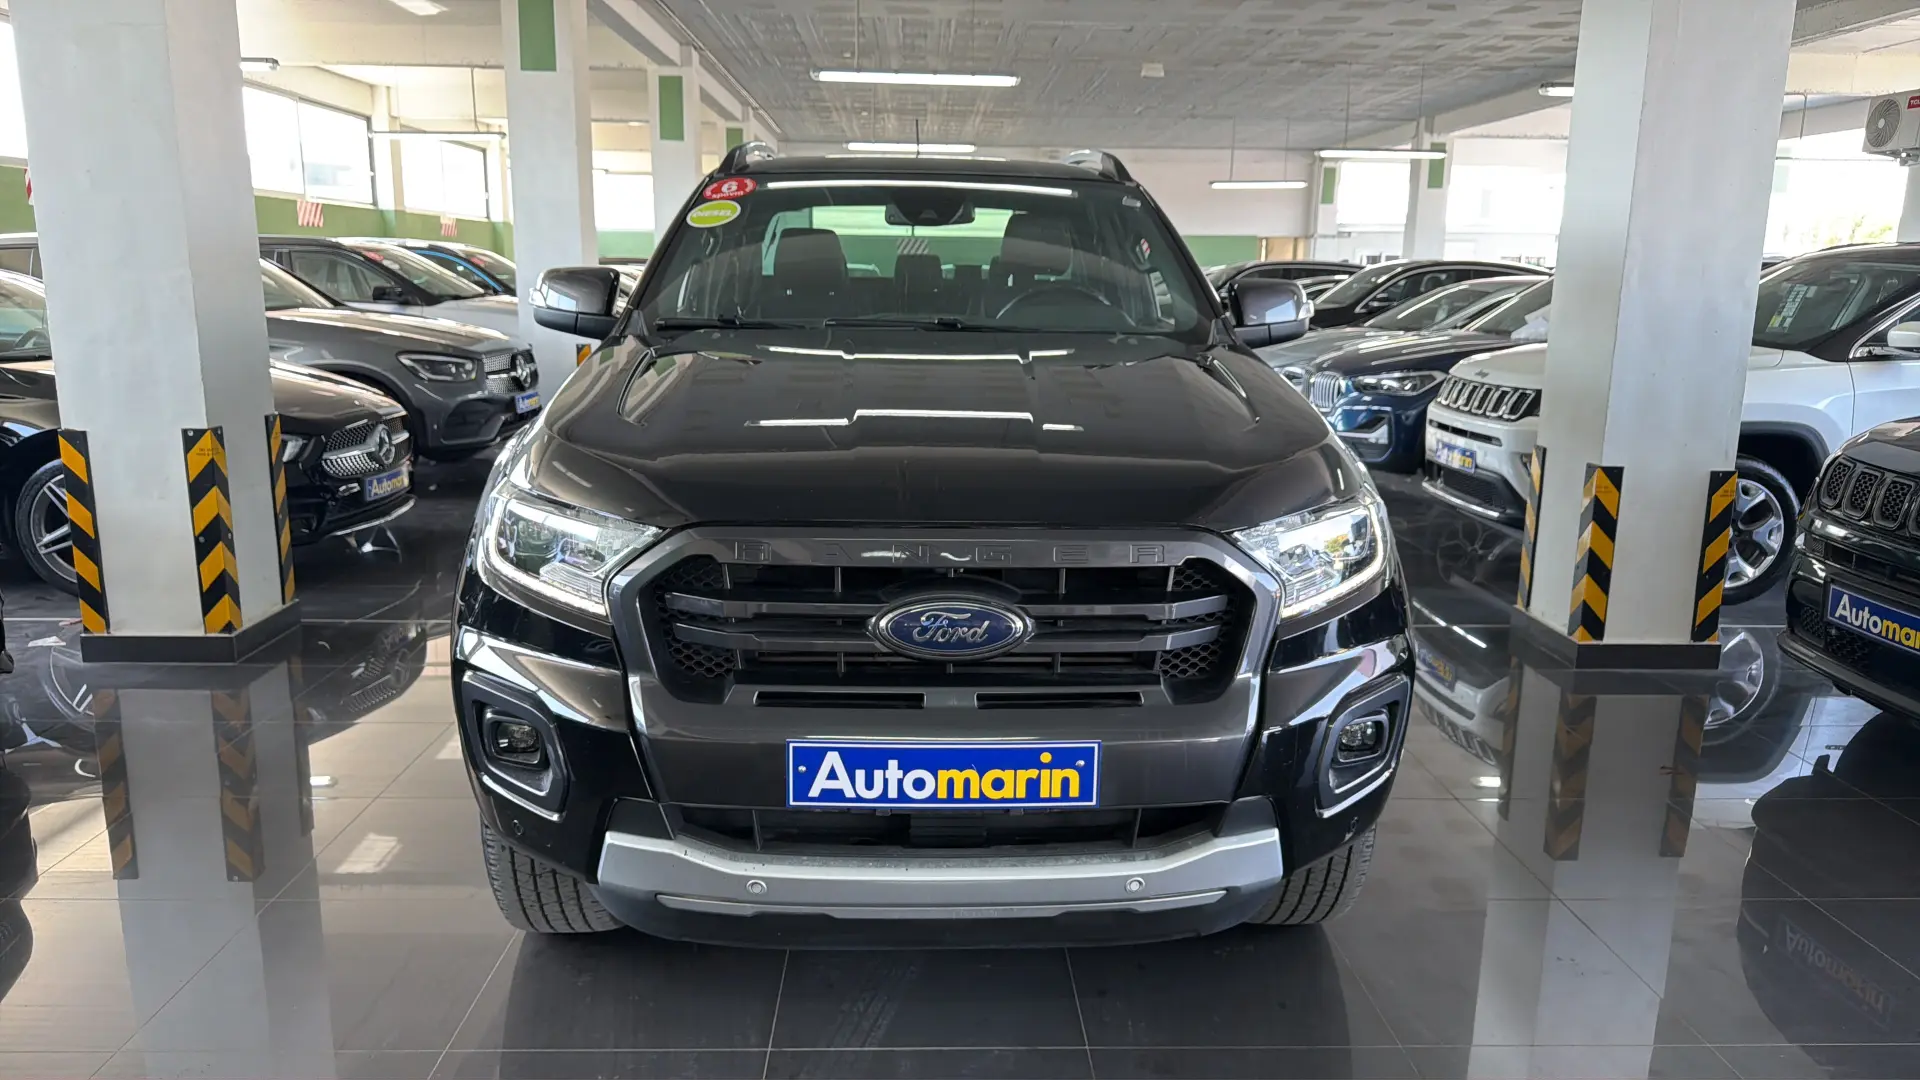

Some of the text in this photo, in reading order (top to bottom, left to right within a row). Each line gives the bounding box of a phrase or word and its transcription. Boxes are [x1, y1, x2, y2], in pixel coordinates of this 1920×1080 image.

[721, 181, 738, 193] 6
[734, 541, 1166, 565] RANGER
[912, 610, 989, 643] Ford
[807, 750, 1080, 799] Automarin
